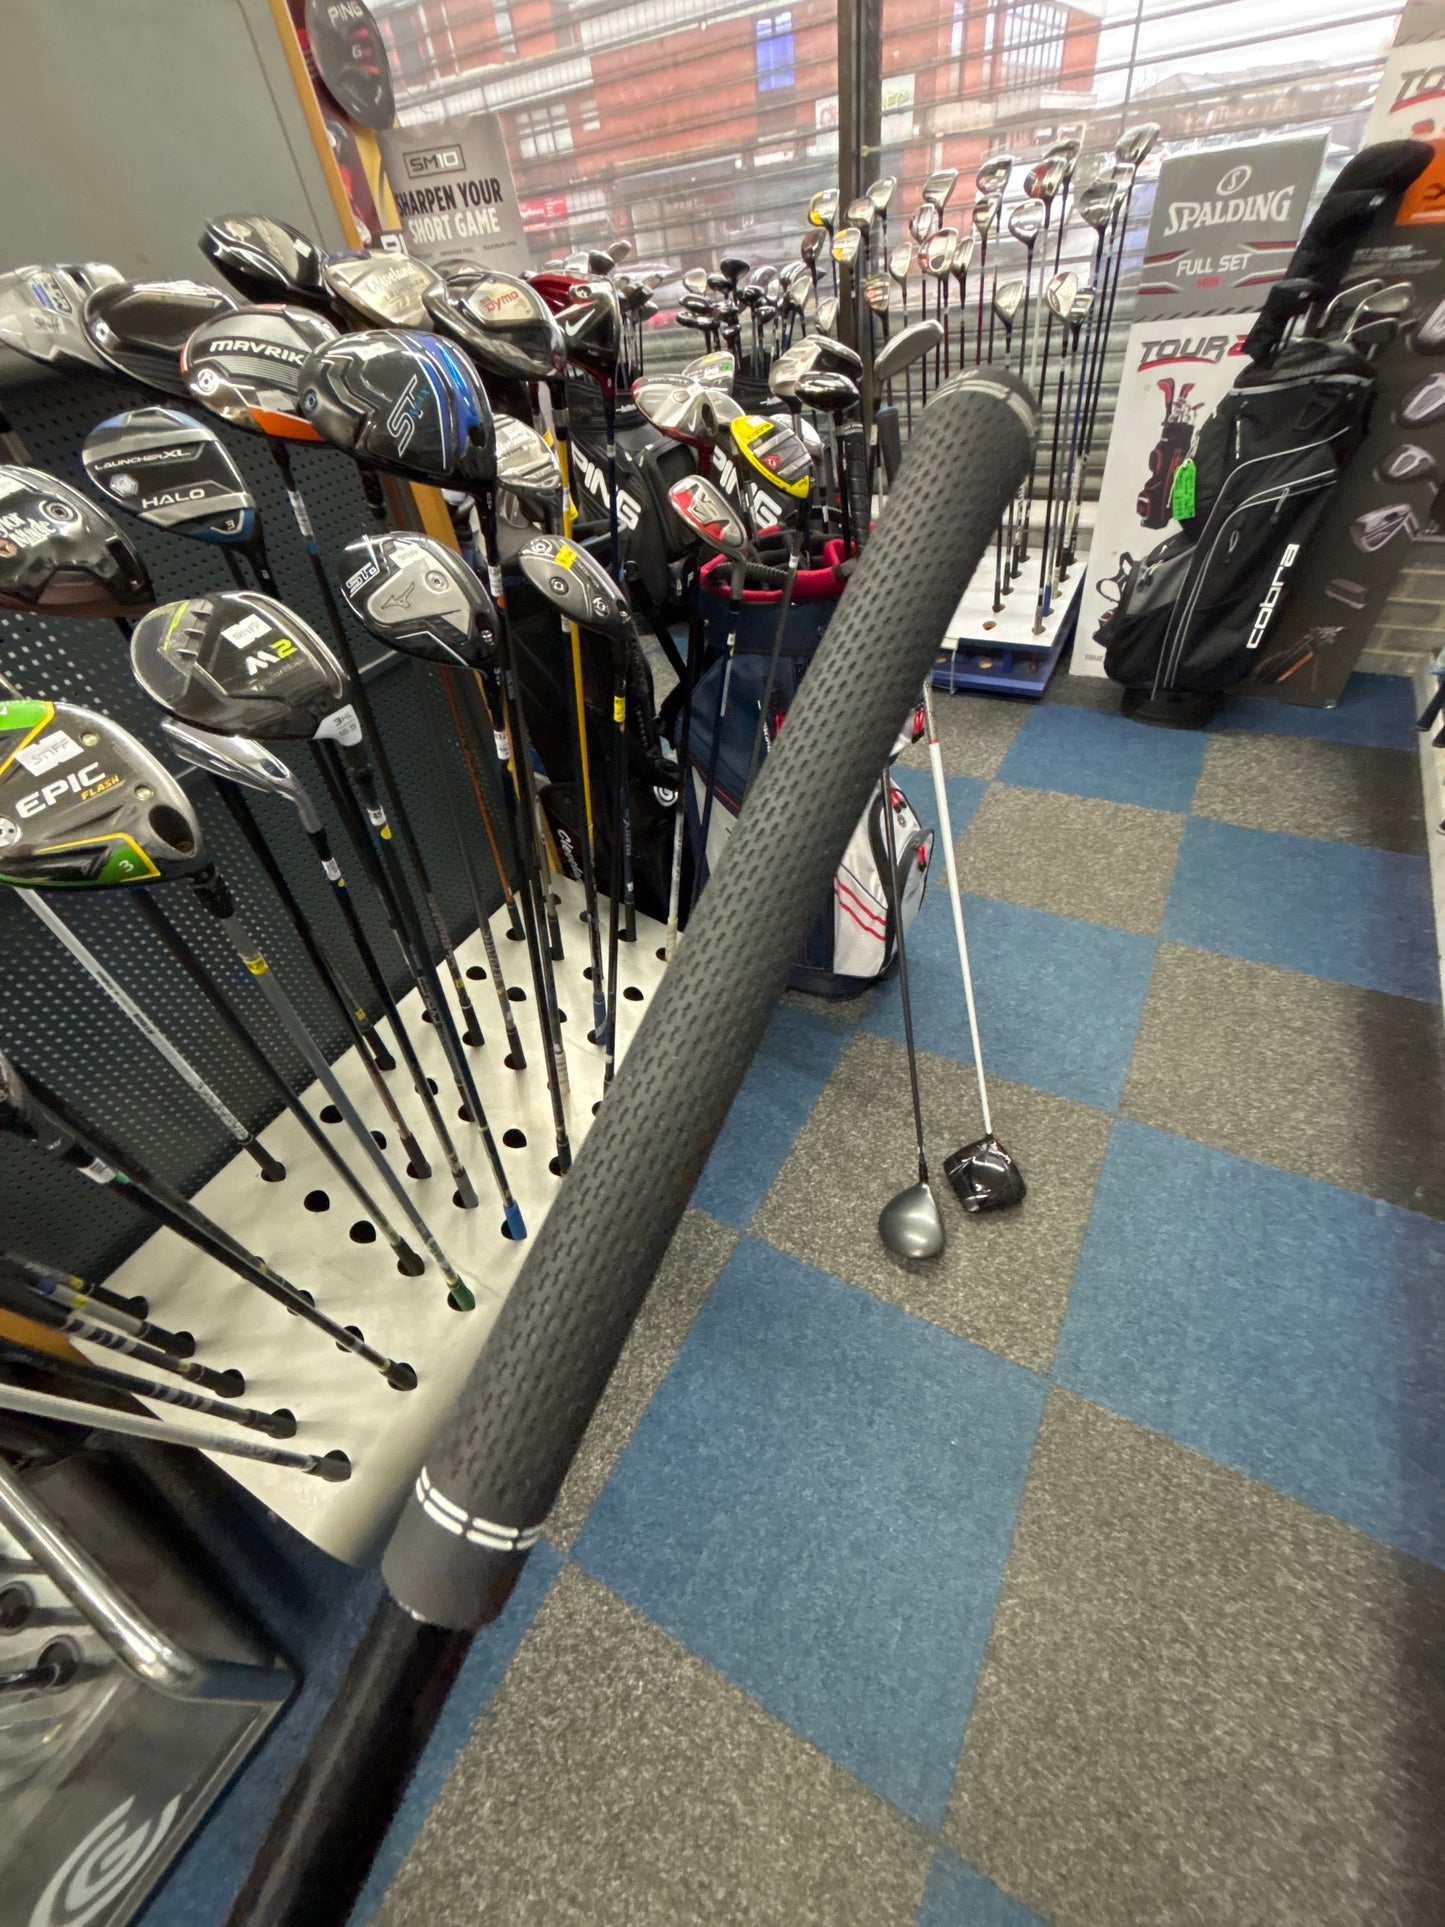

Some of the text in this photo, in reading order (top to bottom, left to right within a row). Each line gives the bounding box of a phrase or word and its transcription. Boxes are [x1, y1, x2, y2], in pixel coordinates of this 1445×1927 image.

[327, 0, 364, 28] PING
[409, 151, 459, 172] SM10
[456, 178, 503, 208] YOUR
[1163, 185, 1296, 237] SPALDING
[407, 214, 452, 245] SHORT
[454, 207, 500, 238] GAME
[1176, 252, 1254, 277] FULL SET
[209, 340, 305, 366] MAVRIK
[1140, 336, 1229, 363] TOUR
[142, 488, 205, 508] HALO
[571, 440, 642, 530] PING
[712, 444, 783, 530] PING
[1246, 543, 1300, 649] cobra
[245, 638, 298, 676] M2
[31, 738, 69, 766] STIFF
[15, 761, 106, 818] EPIC
[81, 775, 120, 801] FLASH
[118, 859, 134, 873] 3
